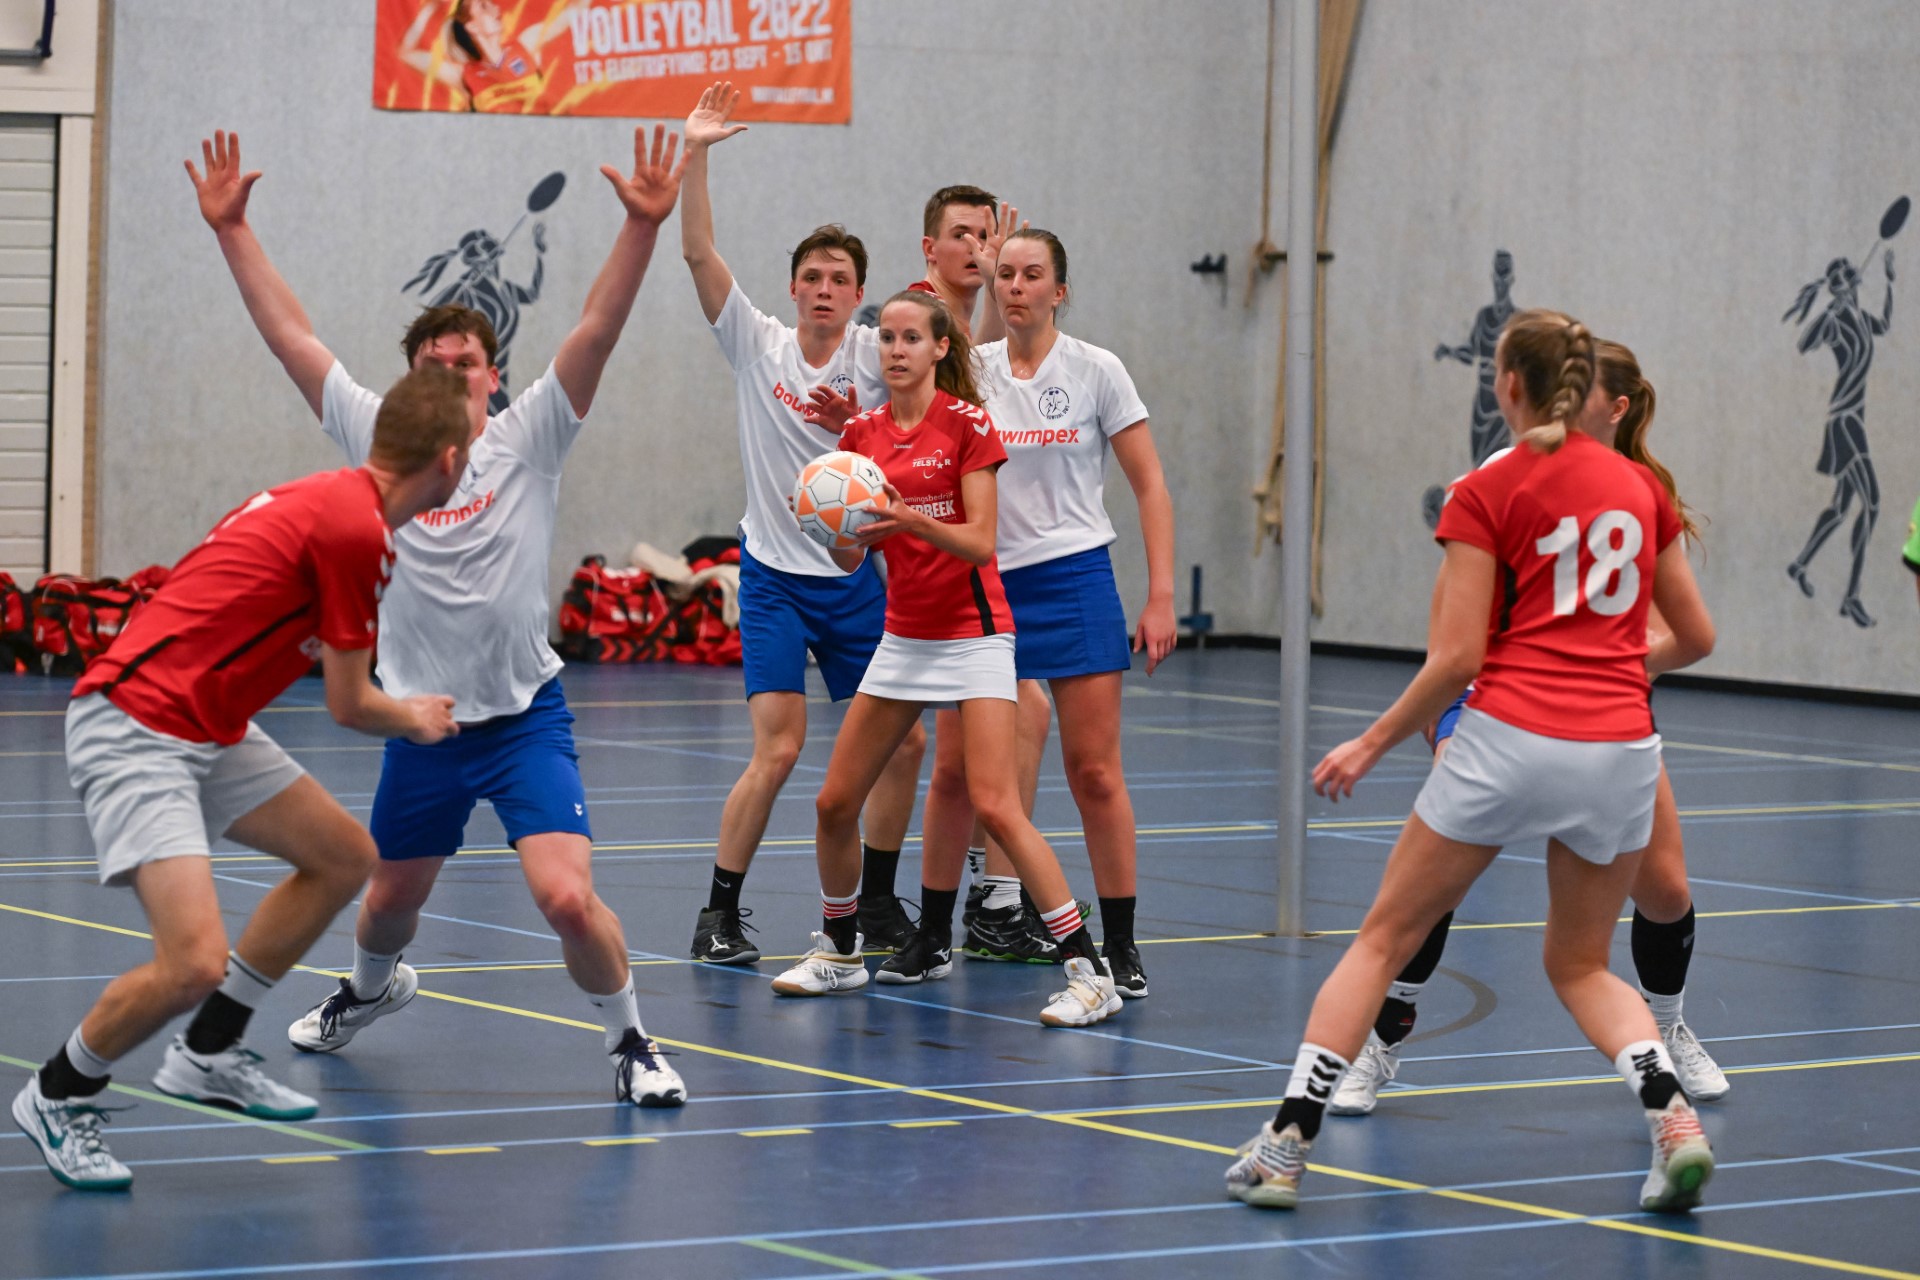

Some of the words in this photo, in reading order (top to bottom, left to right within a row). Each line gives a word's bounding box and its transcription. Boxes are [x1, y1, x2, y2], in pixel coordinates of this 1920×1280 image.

[568, 0, 740, 57] VOLLEYBAL
[747, 0, 832, 41] 2022
[710, 48, 730, 73] 23
[733, 44, 768, 71] SEPT
[996, 428, 1079, 447] wimpex
[902, 490, 954, 504] emingsbedrijf
[1535, 509, 1643, 616] 18
